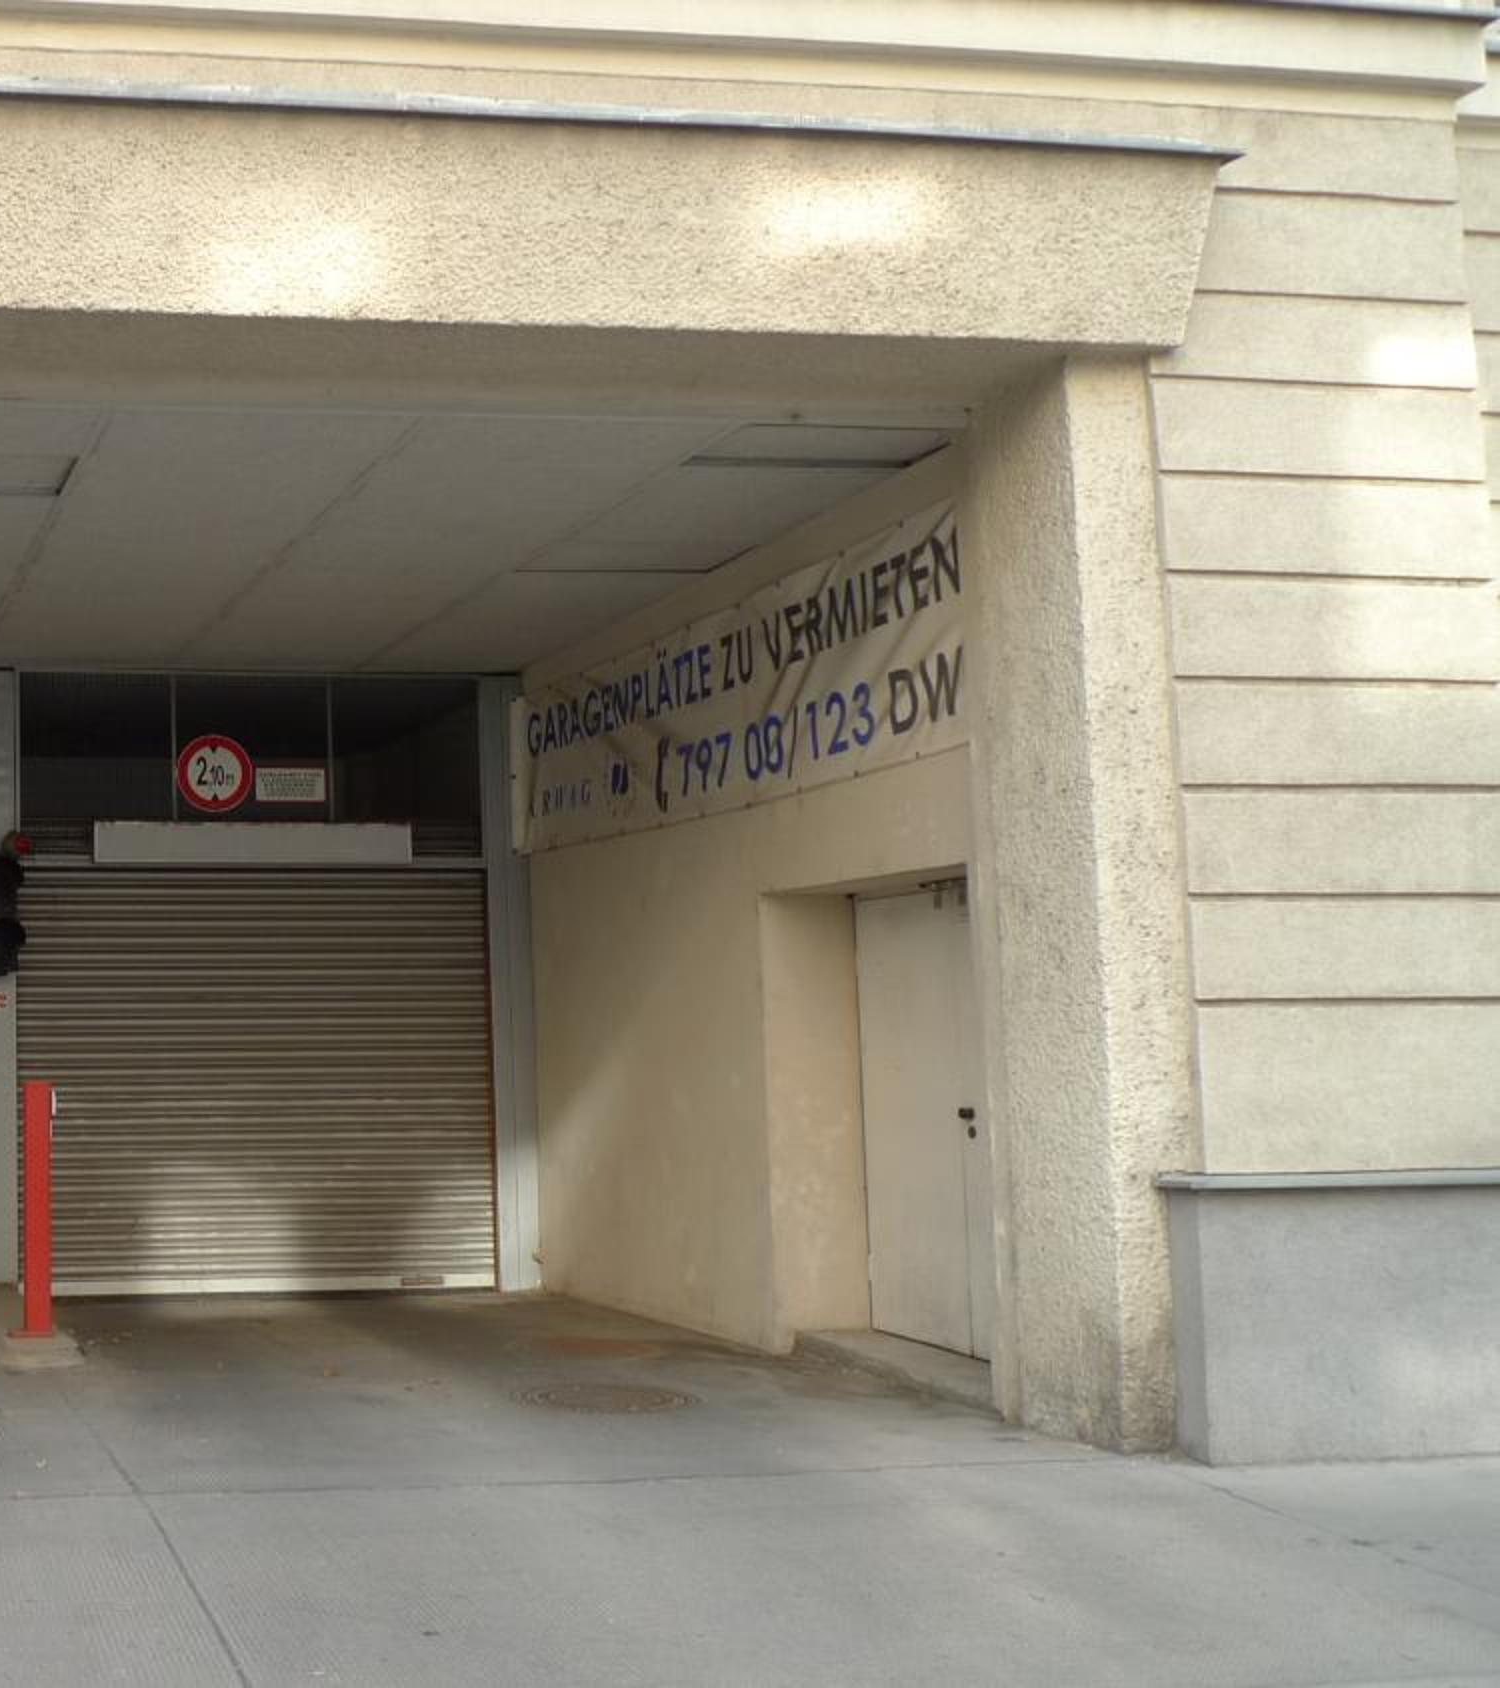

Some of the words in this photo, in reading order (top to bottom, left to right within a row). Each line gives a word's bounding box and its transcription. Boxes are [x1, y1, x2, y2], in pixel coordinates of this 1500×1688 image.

[527, 643, 712, 757] GARAGENPLÄTZE
[720, 624, 753, 693] ZU
[761, 527, 960, 673] VERMIETEN
[675, 732, 732, 798] 797
[887, 645, 963, 736] DW
